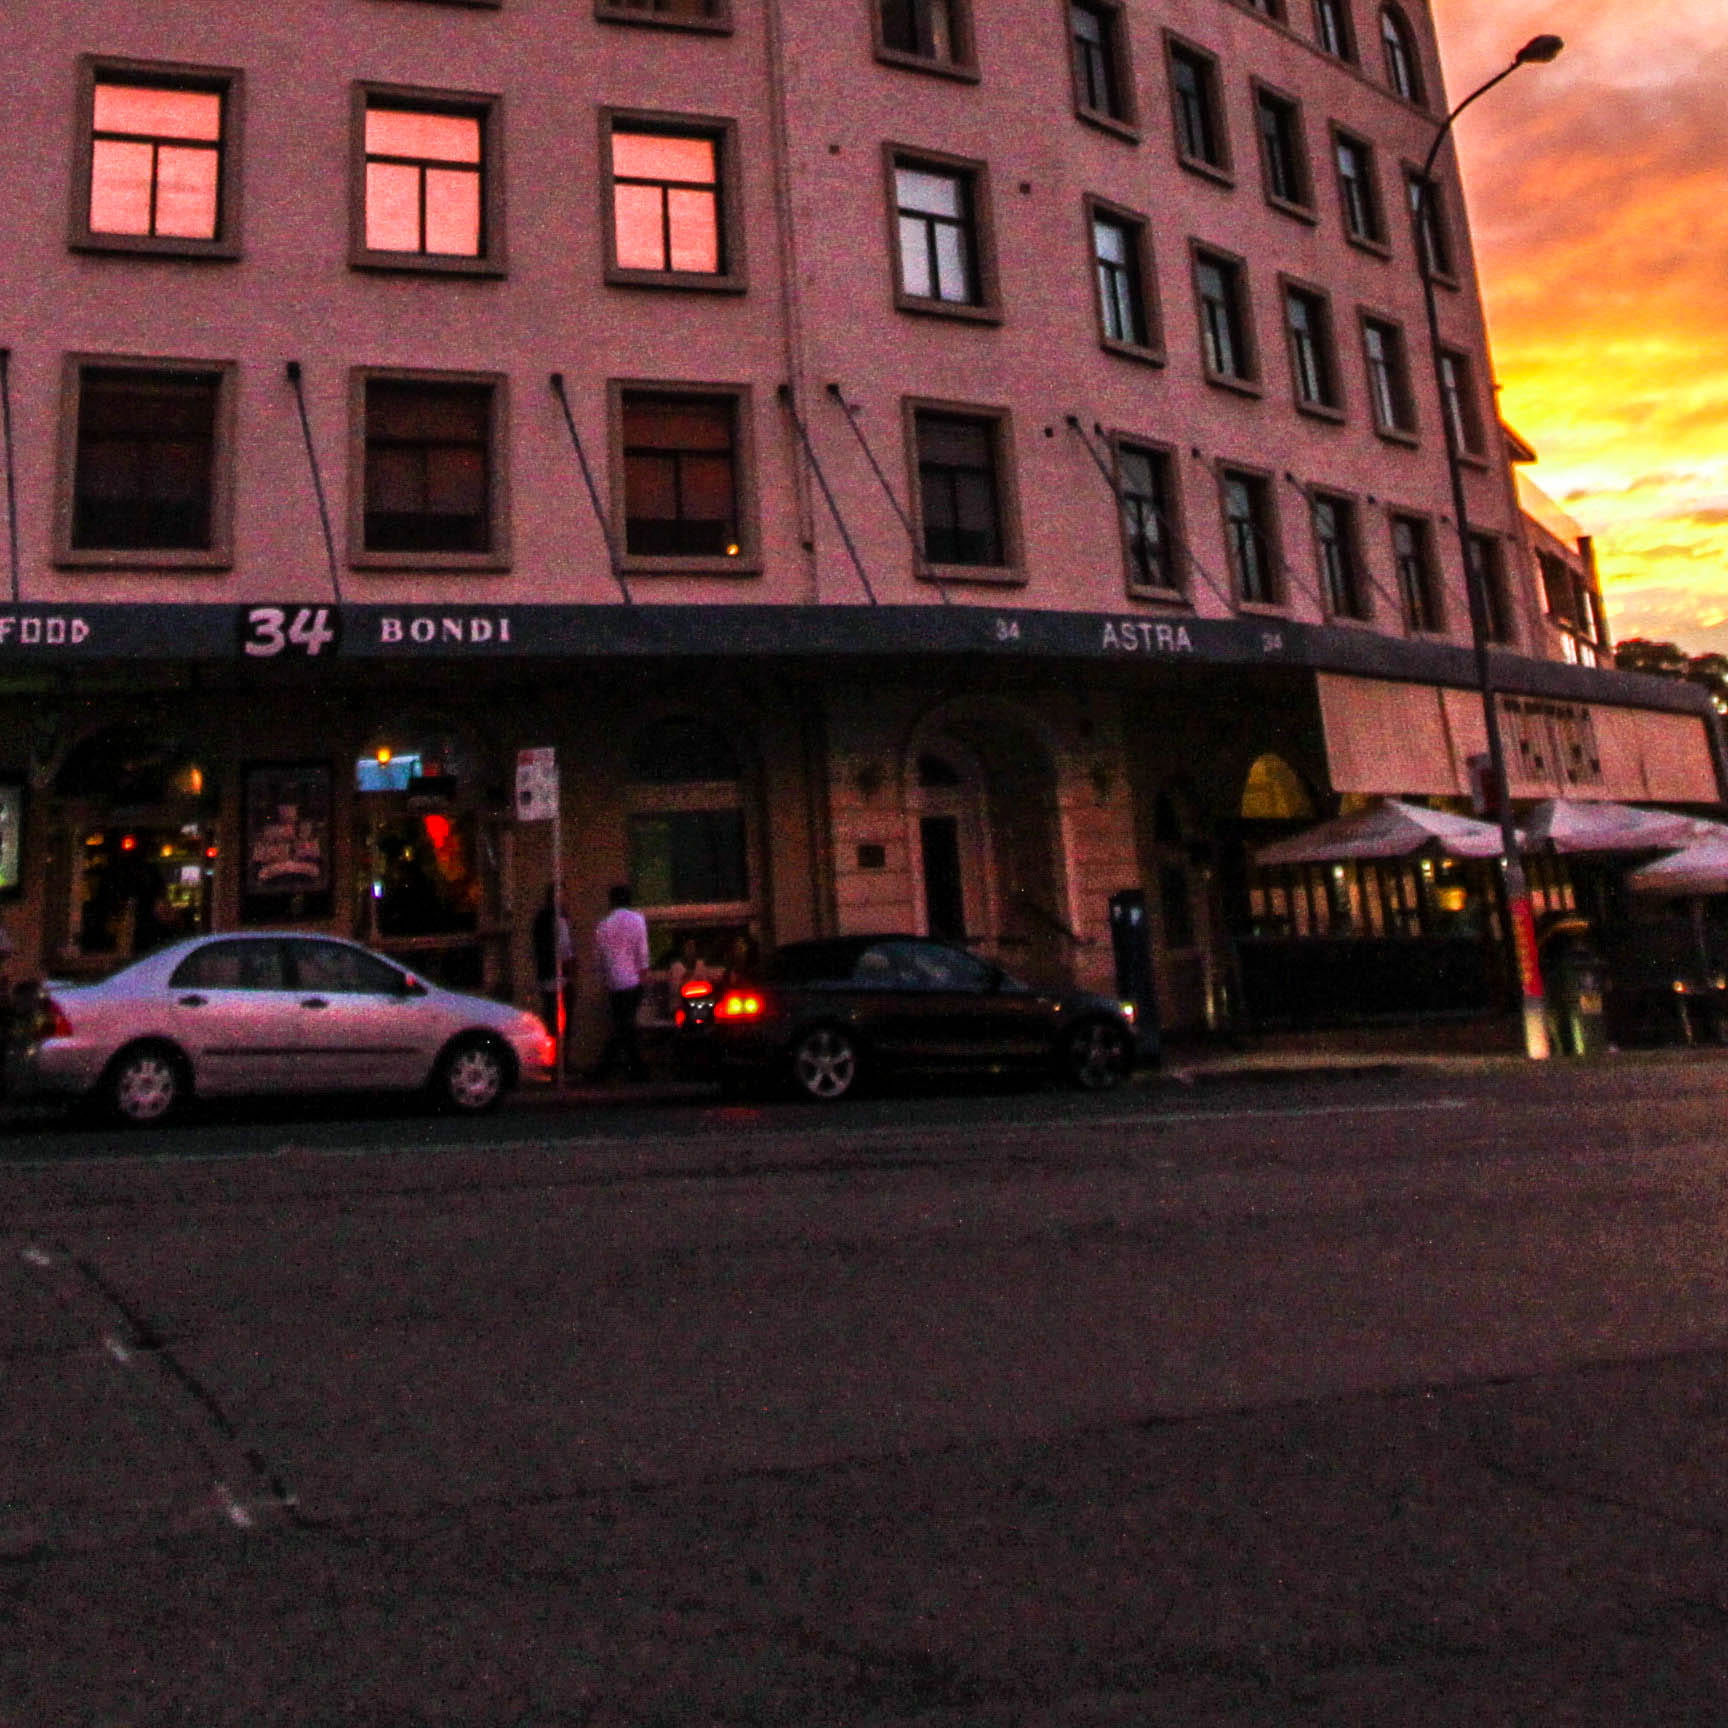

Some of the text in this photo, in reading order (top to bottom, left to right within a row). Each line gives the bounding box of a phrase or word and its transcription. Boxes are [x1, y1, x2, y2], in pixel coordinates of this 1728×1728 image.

[244, 608, 335, 657] 34
[381, 618, 511, 643] BONDI
[995, 617, 1021, 641] 34
[1102, 621, 1195, 653] ASTRA
